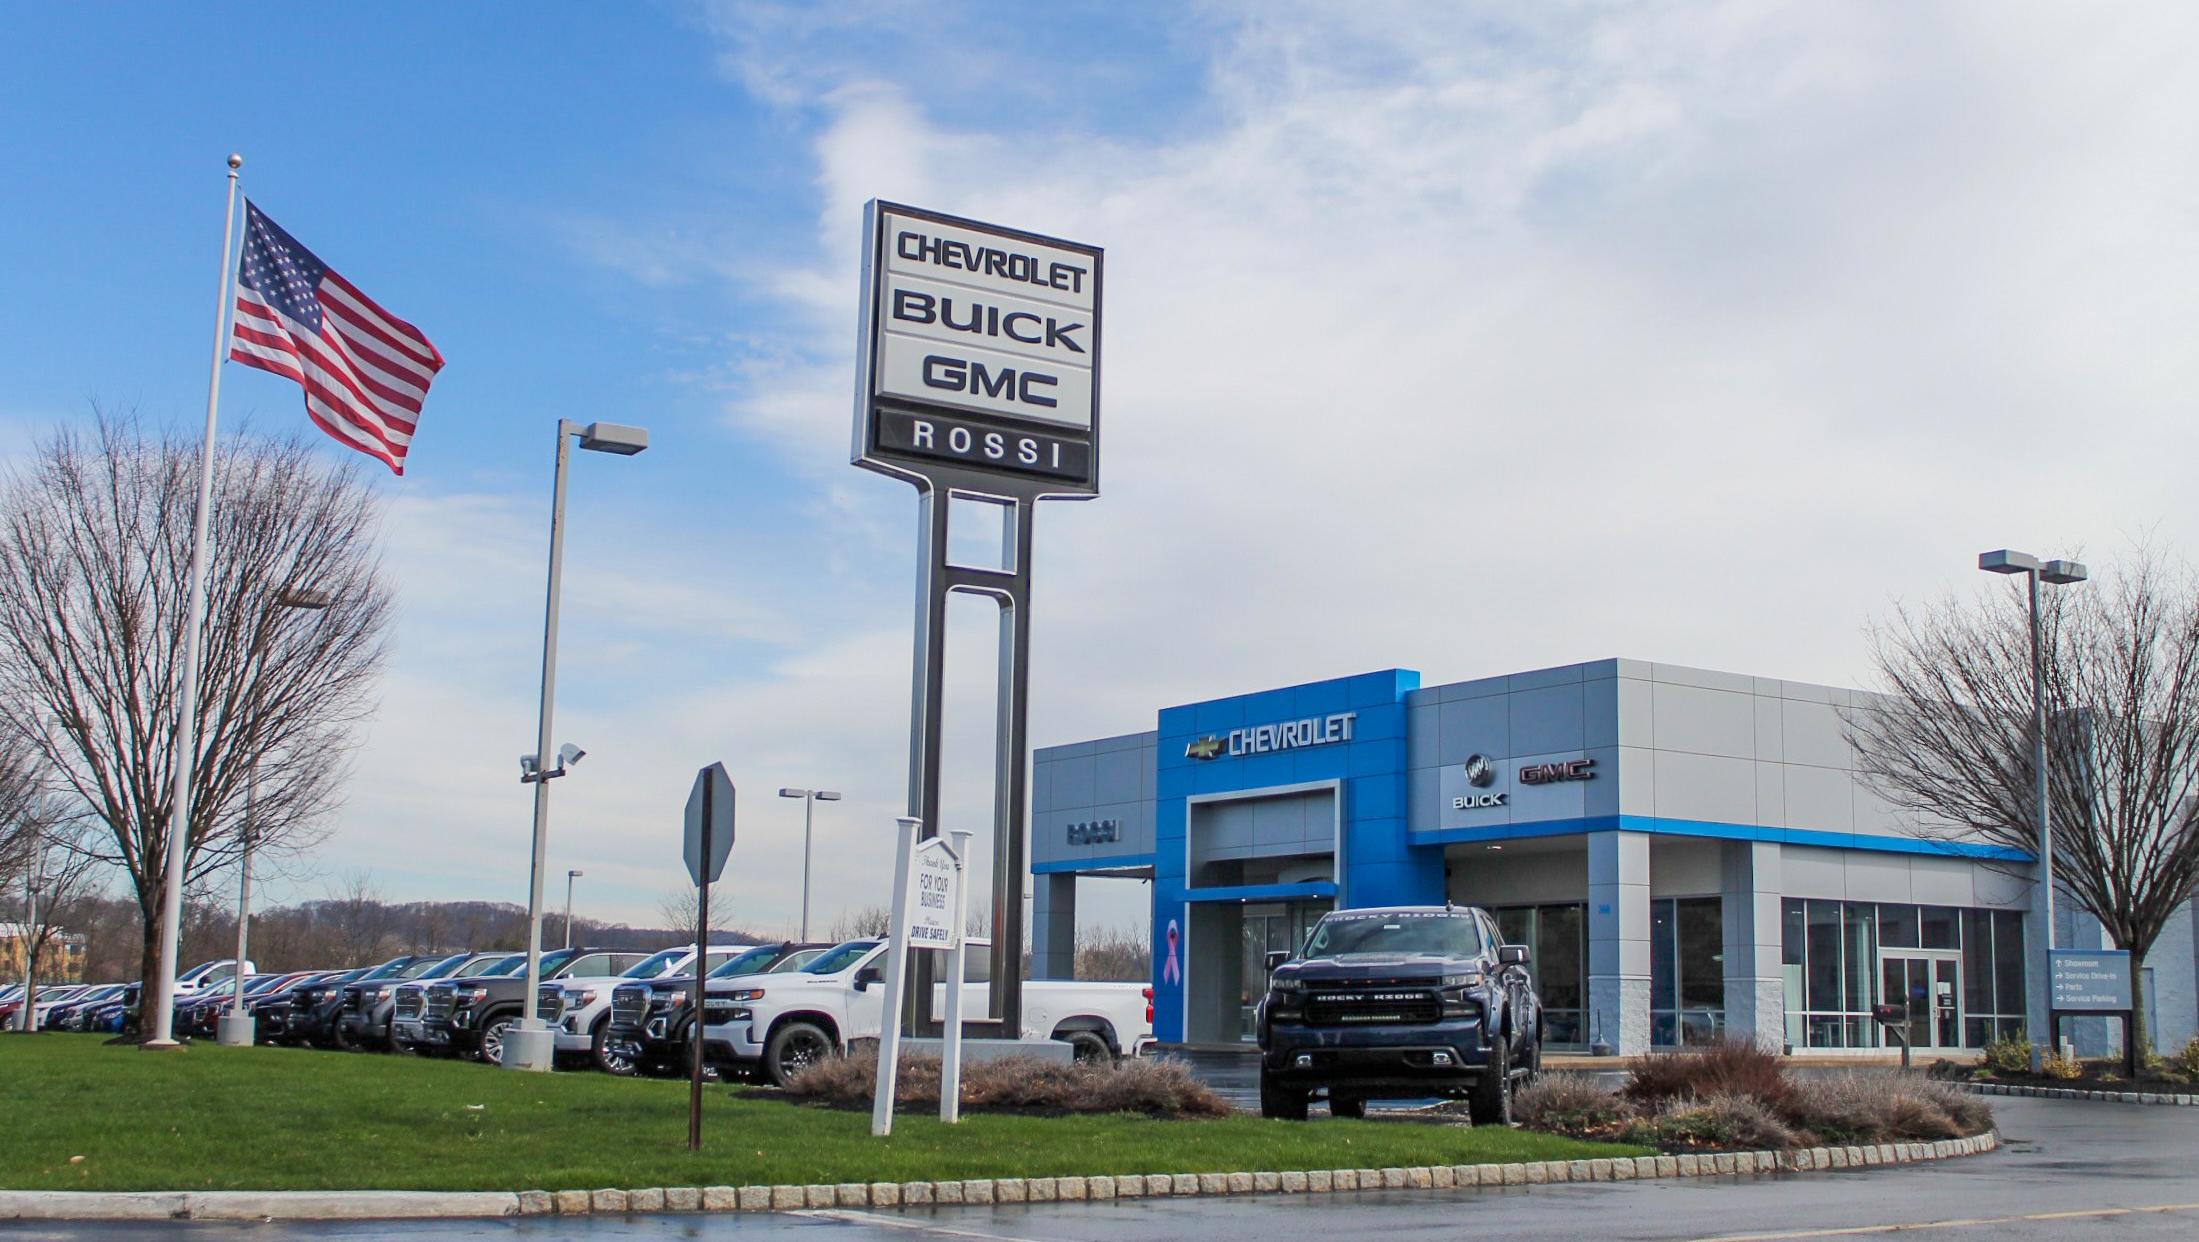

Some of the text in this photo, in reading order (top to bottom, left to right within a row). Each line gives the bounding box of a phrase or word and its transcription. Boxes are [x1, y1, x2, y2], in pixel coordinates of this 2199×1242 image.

[897, 231, 1088, 293] CHEVROLET
[893, 288, 1087, 353] BUICK
[922, 354, 1058, 408] GMC
[912, 420, 1060, 468] ROSSI
[1228, 712, 1357, 756] CHEVROLET
[1519, 759, 1593, 785] GMC
[1452, 793, 1505, 810] BUICK
[919, 873, 949, 893] FOR YOUR
[920, 891, 946, 910] BUSINESS
[911, 925, 949, 941] DRIVE SAFELY
